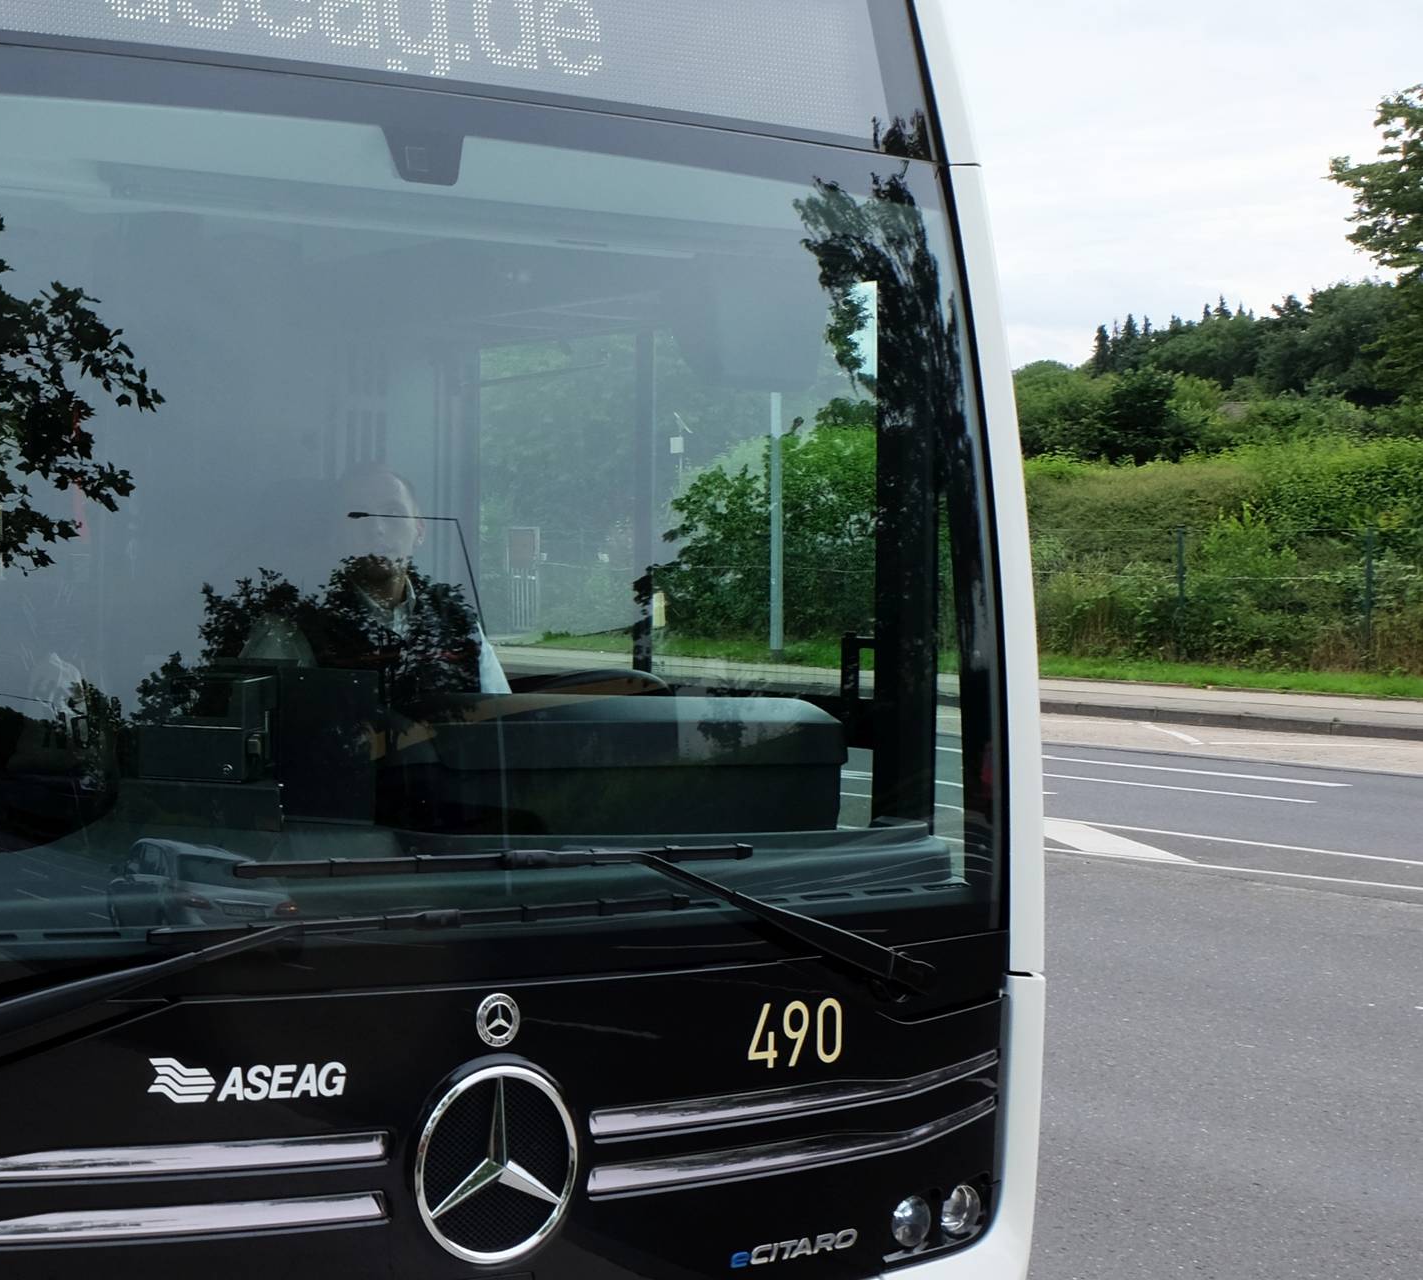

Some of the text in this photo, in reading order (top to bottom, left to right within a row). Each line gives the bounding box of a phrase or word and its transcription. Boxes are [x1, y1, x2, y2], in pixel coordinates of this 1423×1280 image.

[747, 997, 843, 1069] 490
[216, 1061, 347, 1102] ASEAG
[731, 1228, 858, 1268] eCITARO
